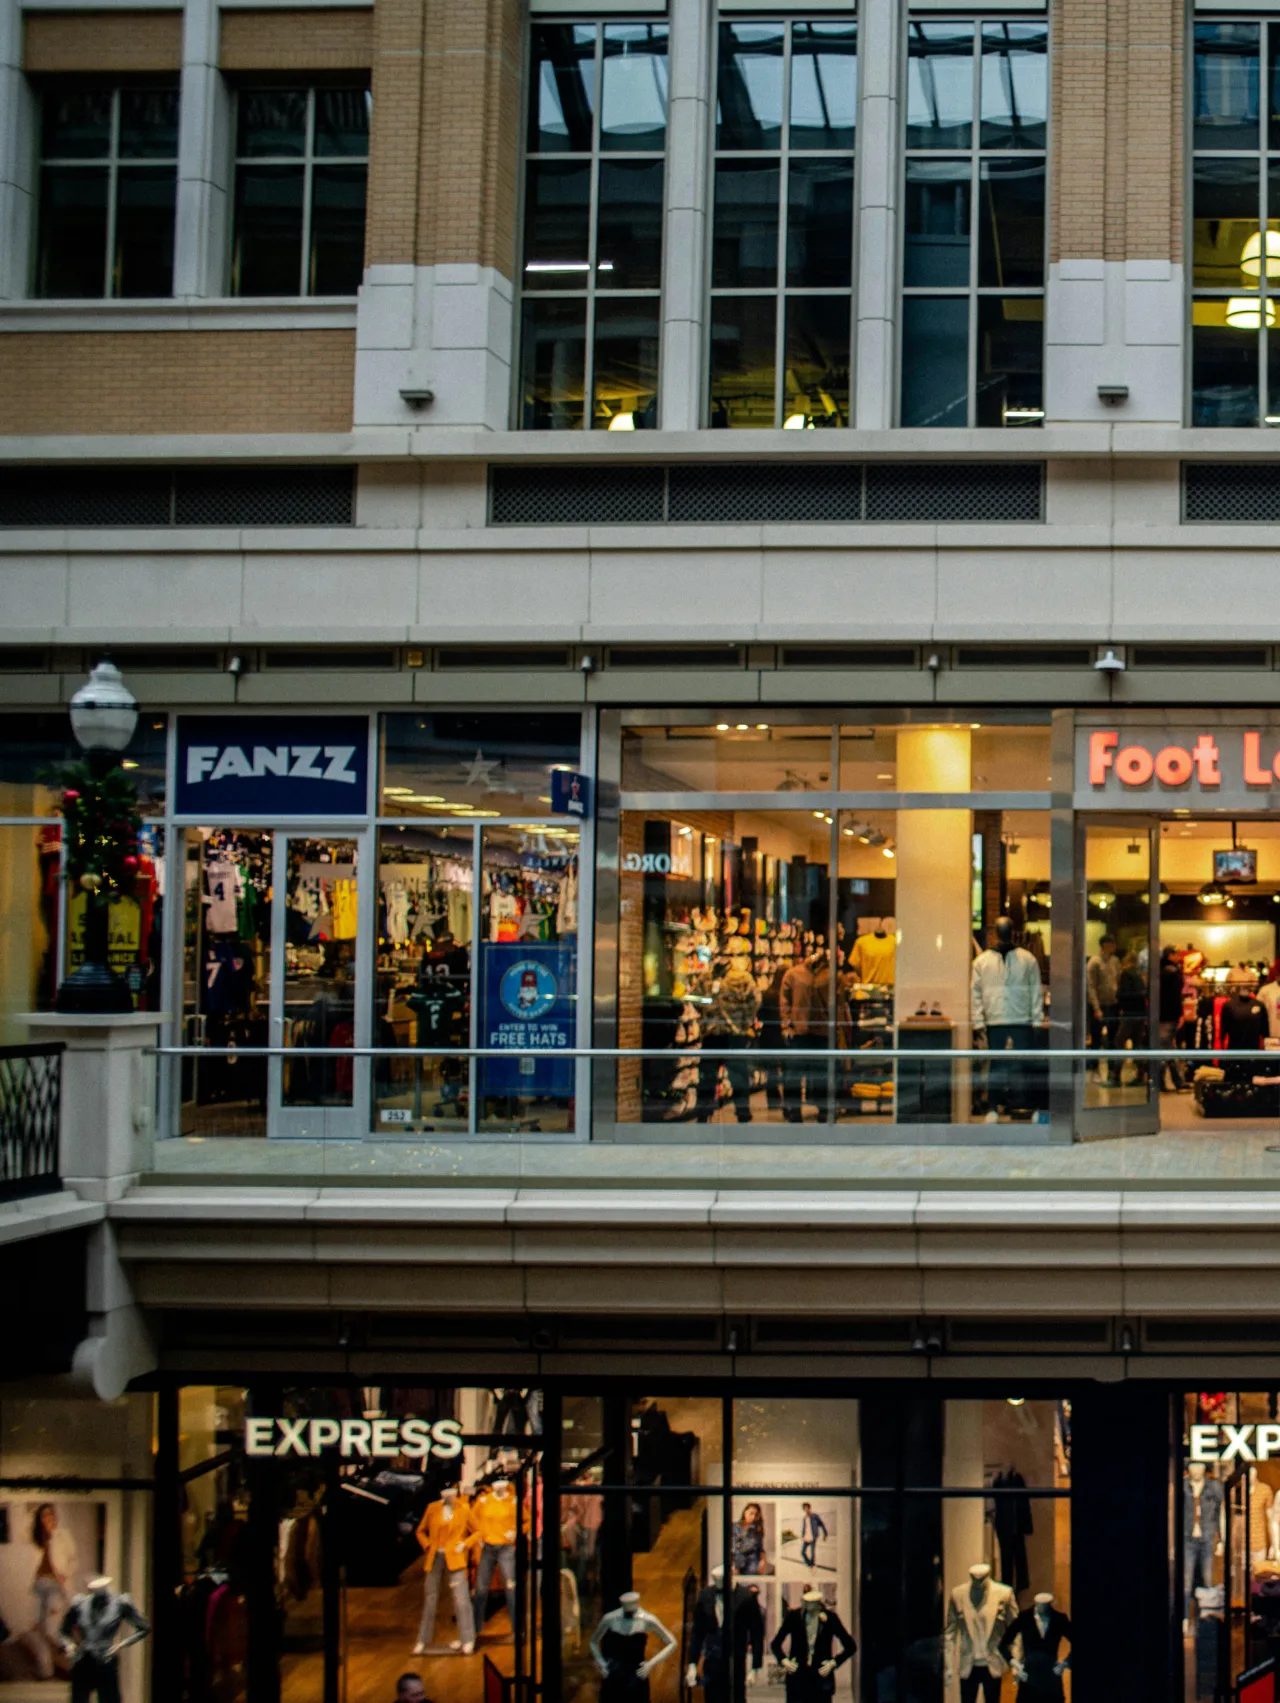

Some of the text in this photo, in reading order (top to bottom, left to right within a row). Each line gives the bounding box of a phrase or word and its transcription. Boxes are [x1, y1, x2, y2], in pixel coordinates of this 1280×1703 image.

[186, 745, 357, 784] FANZZ
[1088, 731, 1221, 786] Foot
[490, 1032, 567, 1046] FREE HATS
[244, 1417, 464, 1459] EXPRESS
